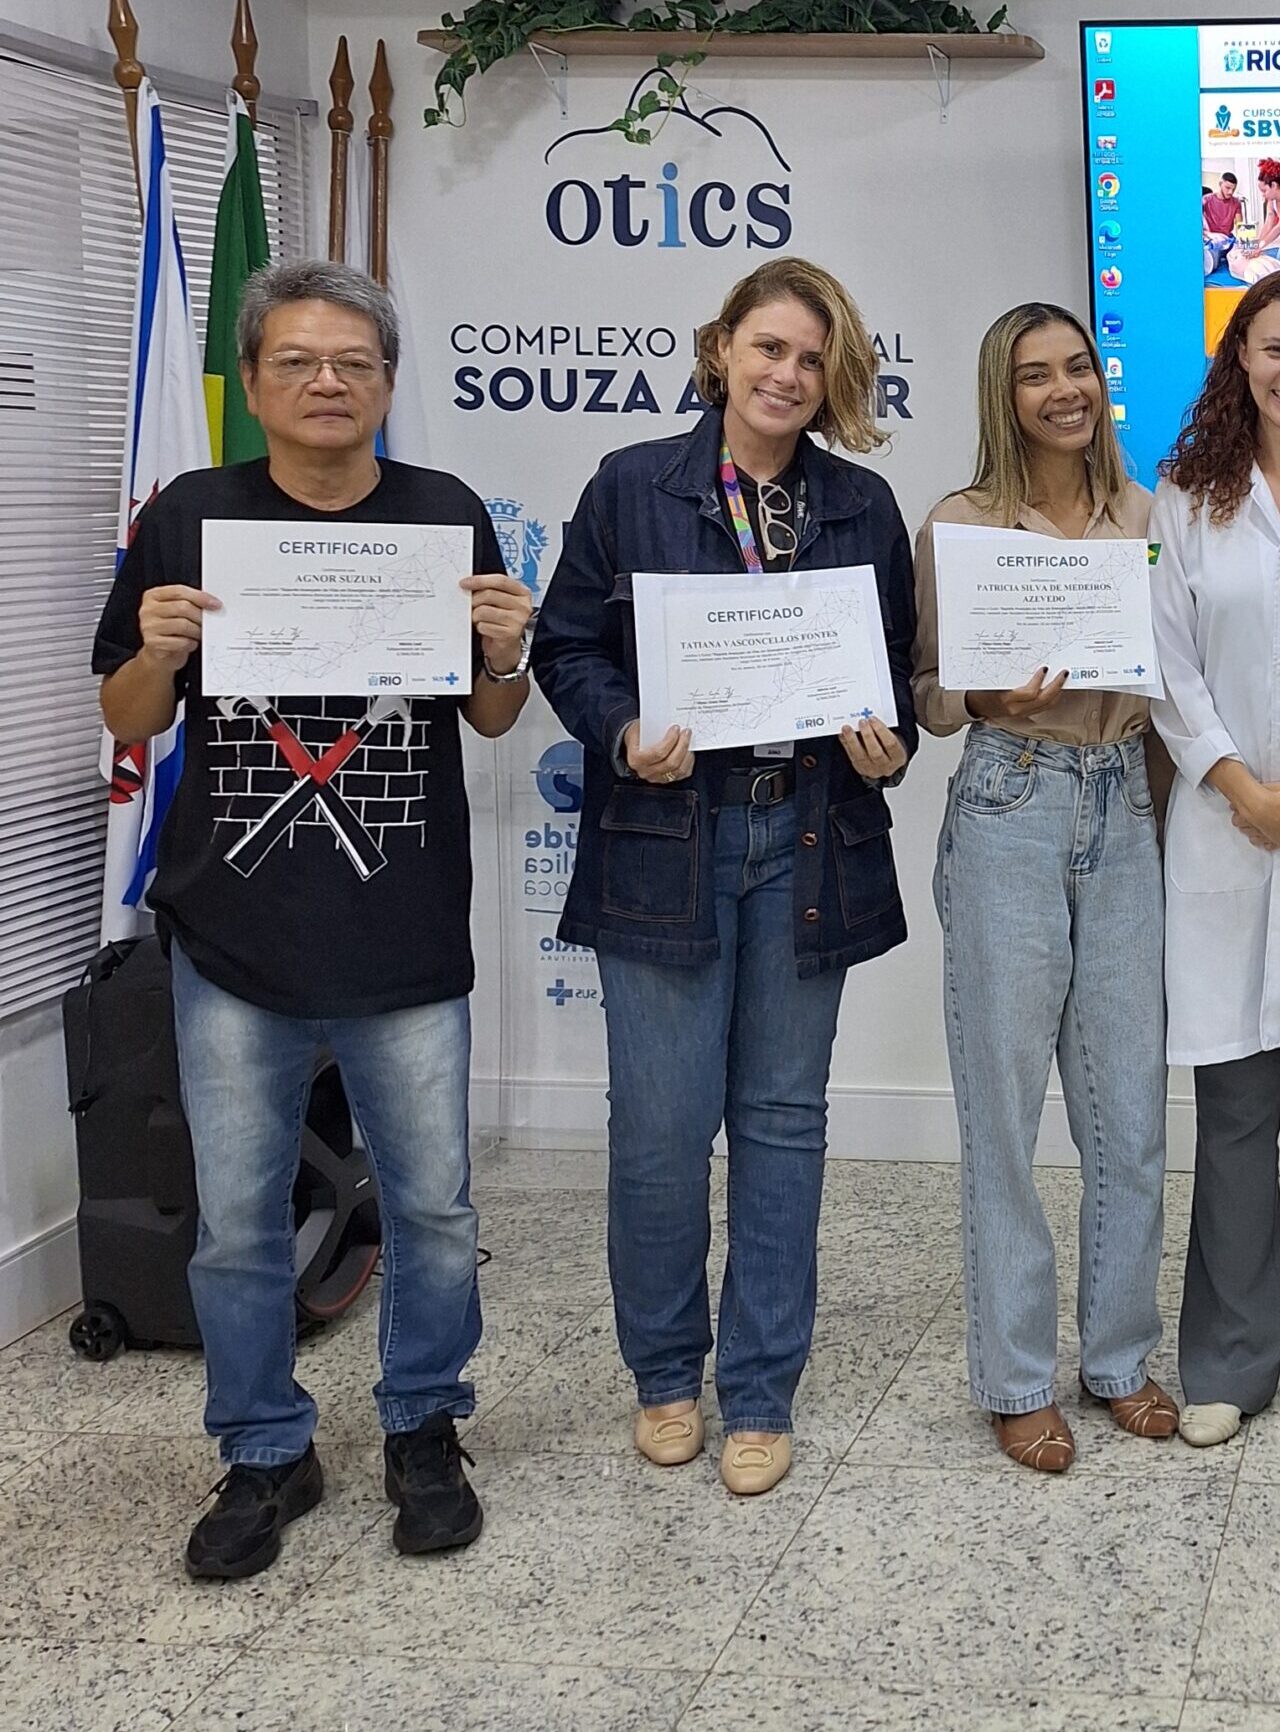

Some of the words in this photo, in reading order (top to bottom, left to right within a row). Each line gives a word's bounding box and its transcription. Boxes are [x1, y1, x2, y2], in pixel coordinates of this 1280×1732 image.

[545, 162, 792, 249] otics
[450, 323, 677, 358] COMPLEXO
[453, 366, 662, 414] SOUZA
[279, 541, 398, 556] CERTIFICADO
[996, 556, 1089, 568] CERTIFICADO
[295, 574, 336, 583] AGNOR
[339, 574, 382, 584] SUZUKI
[977, 583, 1019, 592] PATRICIA
[1021, 583, 1047, 592] SILVA
[1050, 583, 1062, 592] DE
[1064, 583, 1112, 592] MEDEIROS
[1023, 595, 1066, 603] AZEVEDO
[707, 606, 803, 623] CERTIFICADO
[680, 640, 721, 650] TATIANA
[723, 634, 799, 648] VASCONCELLOS
[800, 631, 838, 642] FONTES
[1080, 670, 1099, 679] RIO
[380, 676, 402, 686] RIO
[805, 718, 825, 728] RIO
